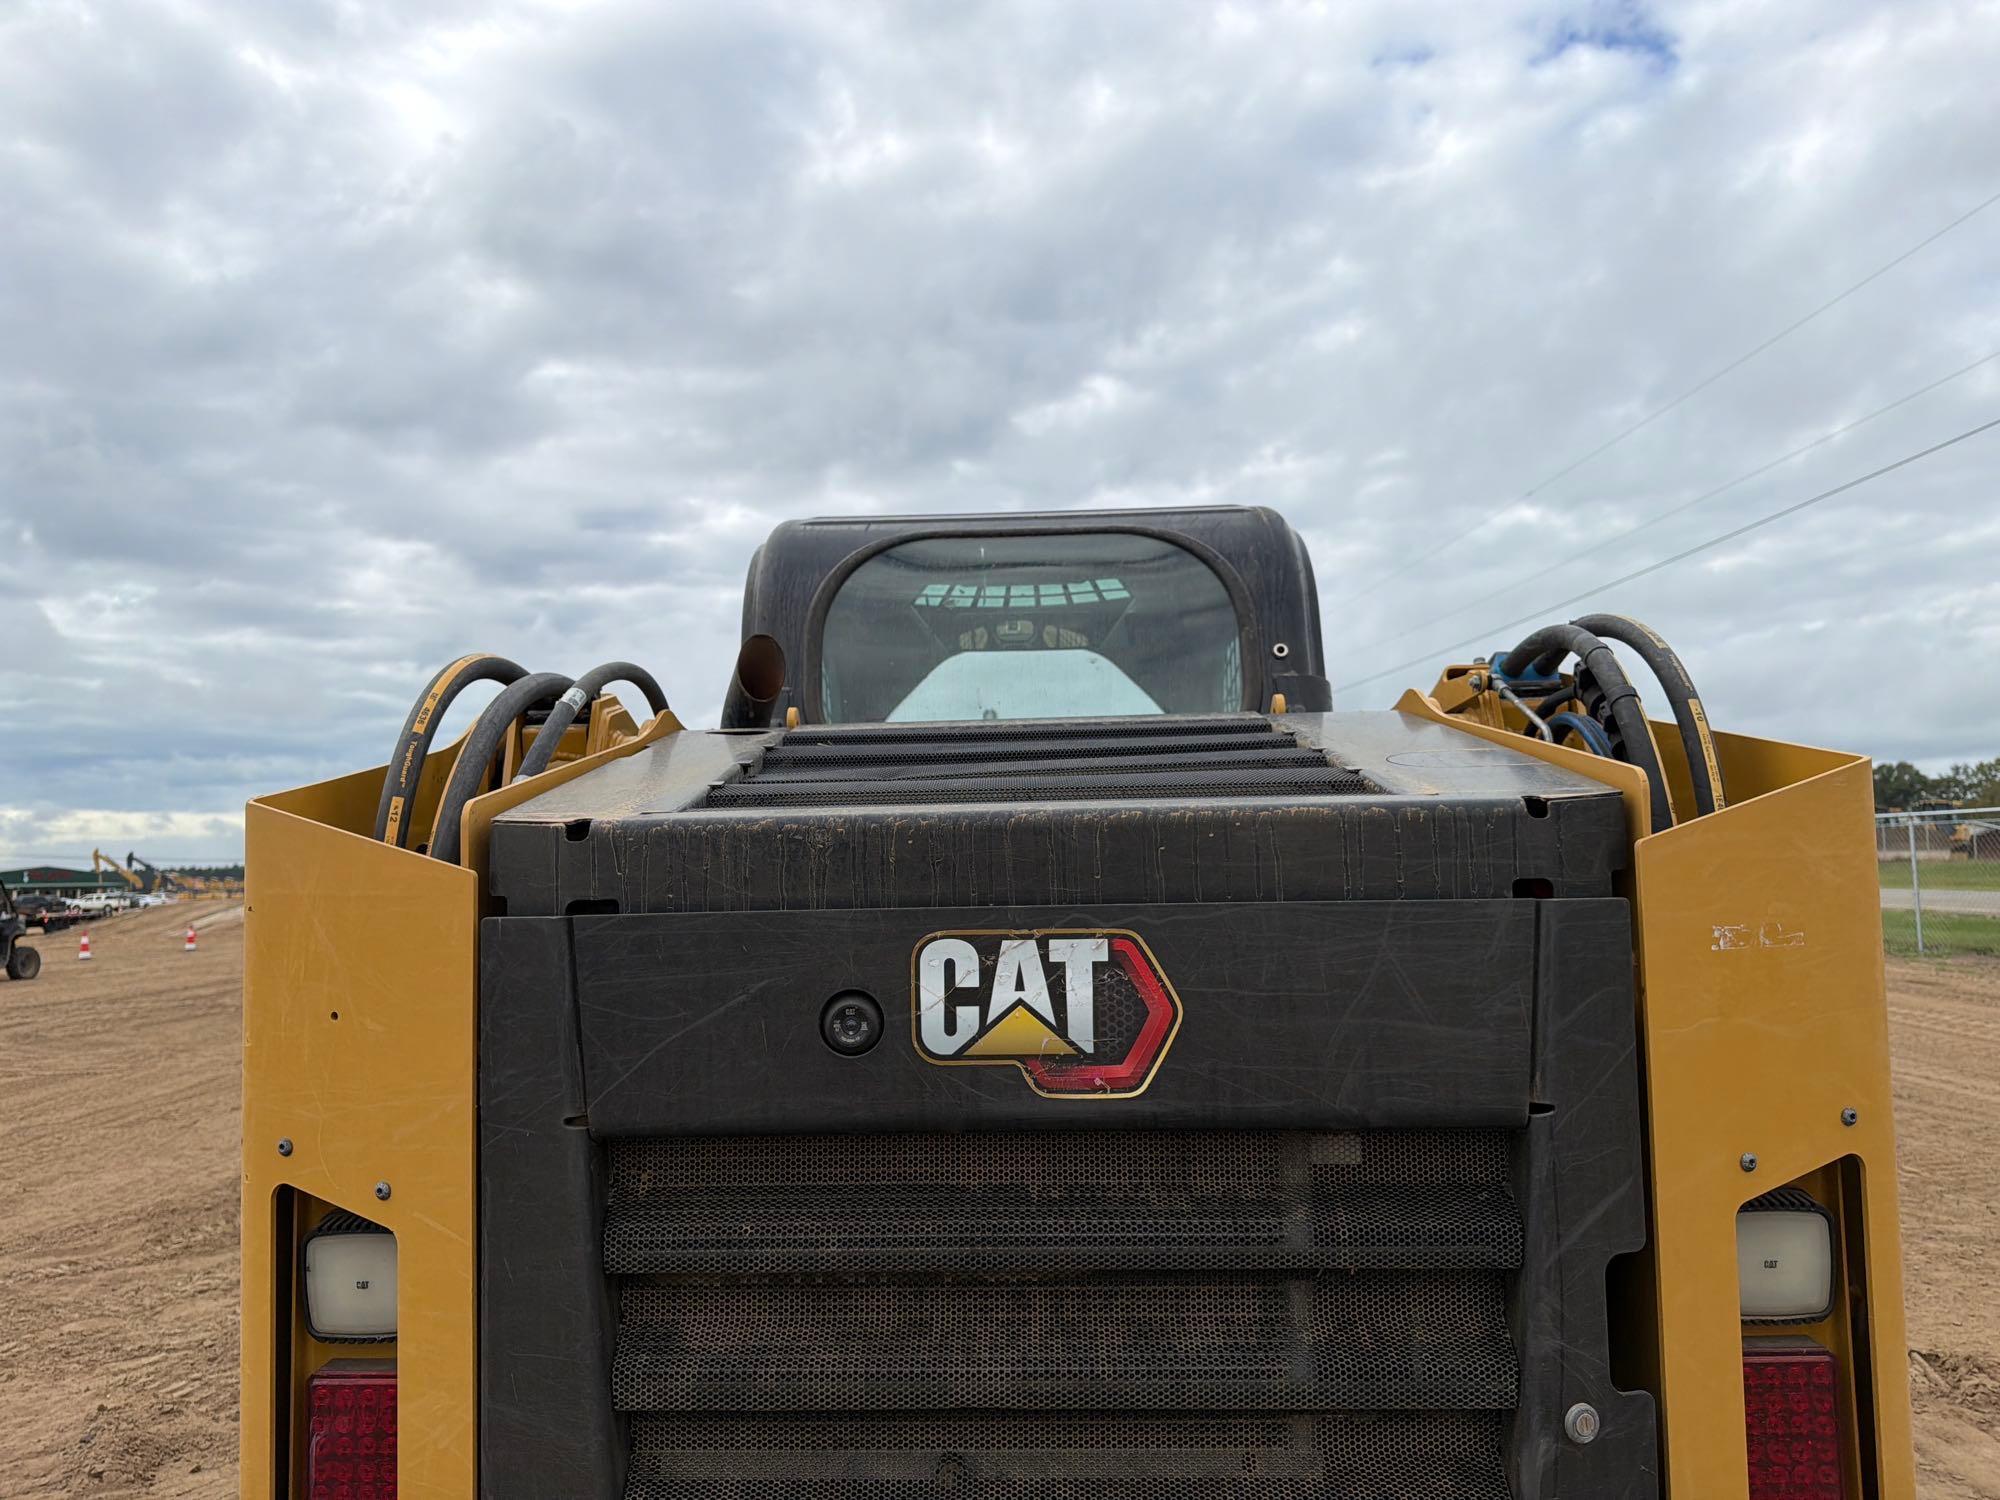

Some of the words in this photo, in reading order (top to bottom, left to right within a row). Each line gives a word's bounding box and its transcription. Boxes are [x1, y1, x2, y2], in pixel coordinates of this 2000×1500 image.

[919, 938, 1109, 1055] CAT
[1763, 1260, 1778, 1269] CAT
[356, 1280, 370, 1290] CAT
